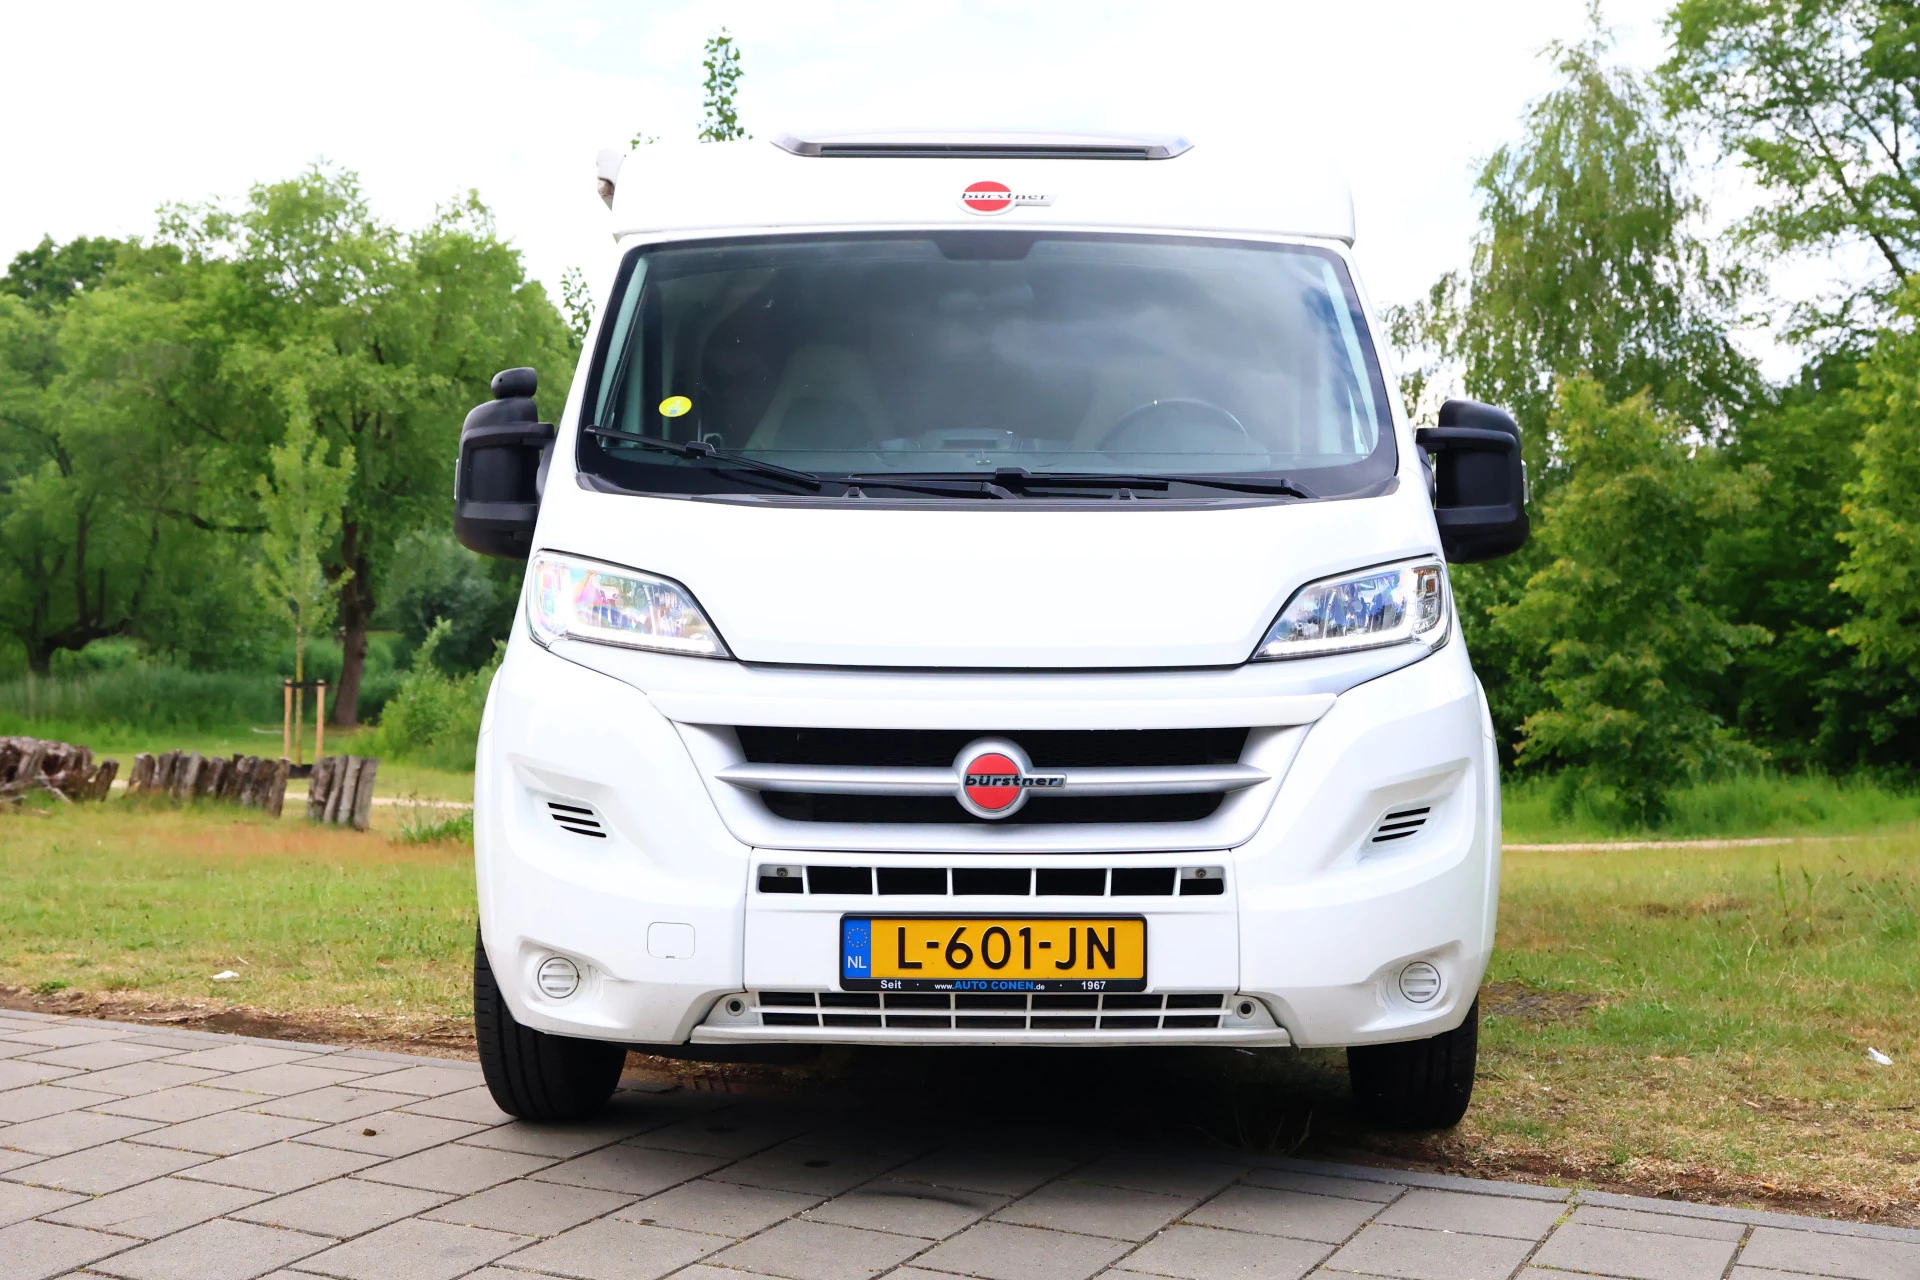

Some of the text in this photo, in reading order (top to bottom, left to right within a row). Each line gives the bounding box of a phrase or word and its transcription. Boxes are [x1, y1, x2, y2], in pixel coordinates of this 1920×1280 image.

[964, 775, 1058, 786] bürstner
[897, 926, 1116, 970] L-601-JN
[847, 955, 867, 969] NL
[880, 979, 902, 989] Seit
[1081, 980, 1107, 991] 1967
